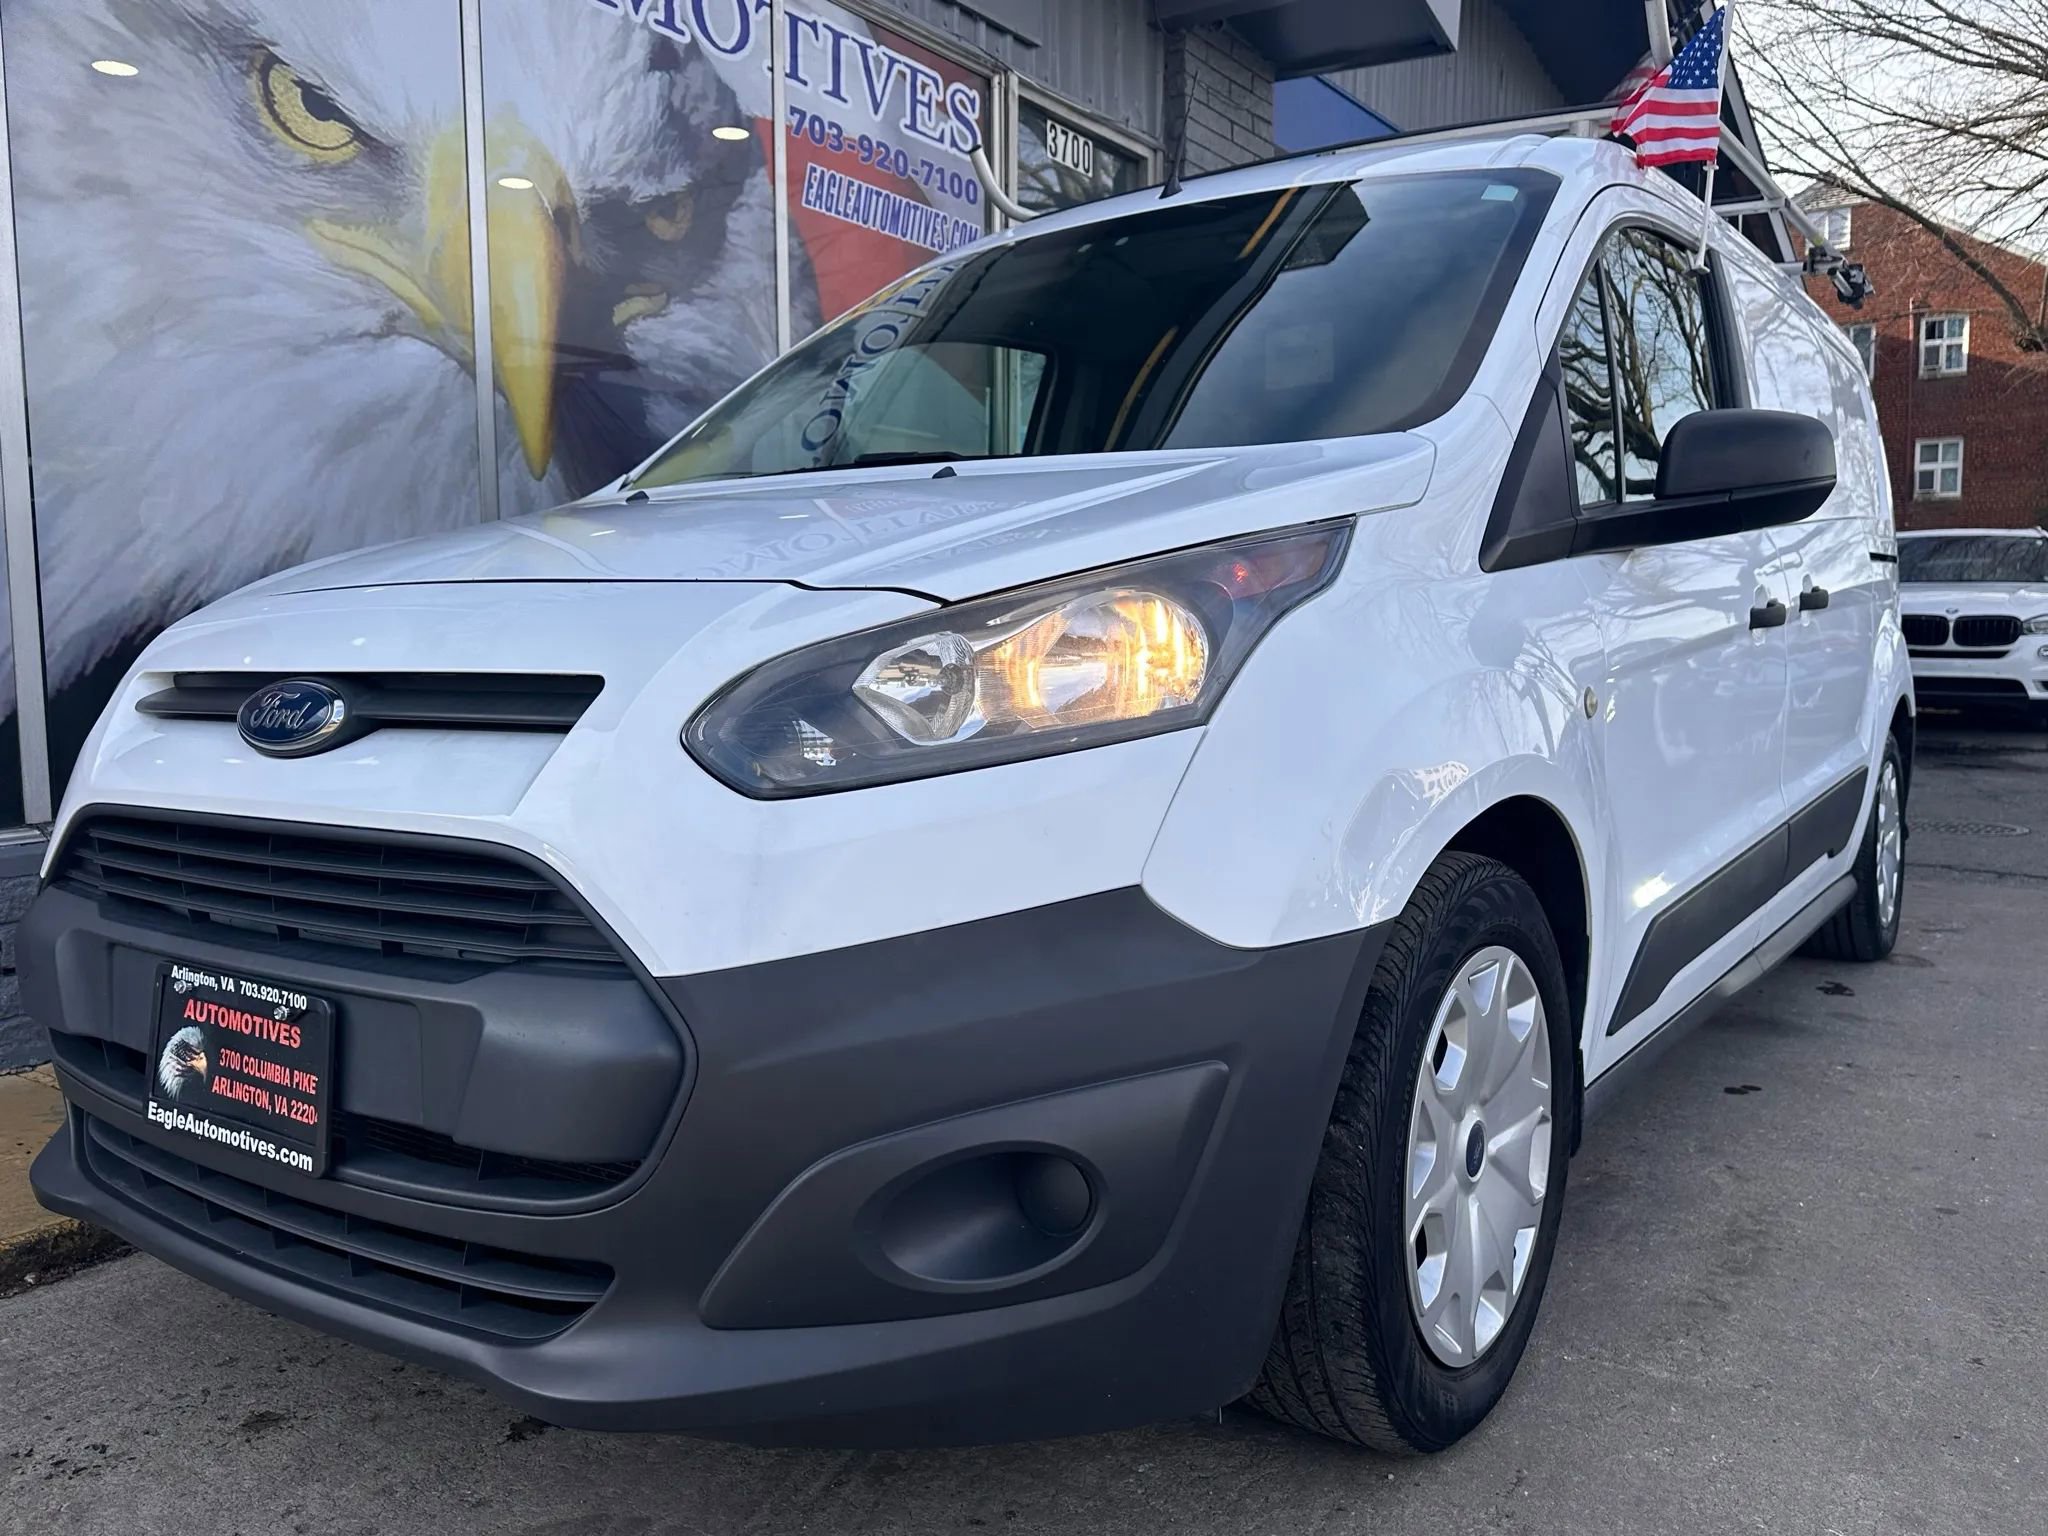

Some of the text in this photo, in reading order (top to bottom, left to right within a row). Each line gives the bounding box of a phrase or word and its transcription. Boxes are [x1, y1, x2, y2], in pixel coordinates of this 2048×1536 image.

[789, 105, 978, 205] 703-920-7100
[1049, 123, 1090, 174] 3700
[250, 690, 312, 729] Ford
[171, 965, 307, 1010] Arlington, VA 703.920.7100
[183, 998, 302, 1049] AUTOMOTIVES
[211, 1075, 272, 1115] ARLINGTON,
[274, 1094, 289, 1116] VA
[219, 1048, 318, 1095] 3700 COLUMBIA PIKE
[147, 1101, 313, 1172] EagleAutomotives.com
